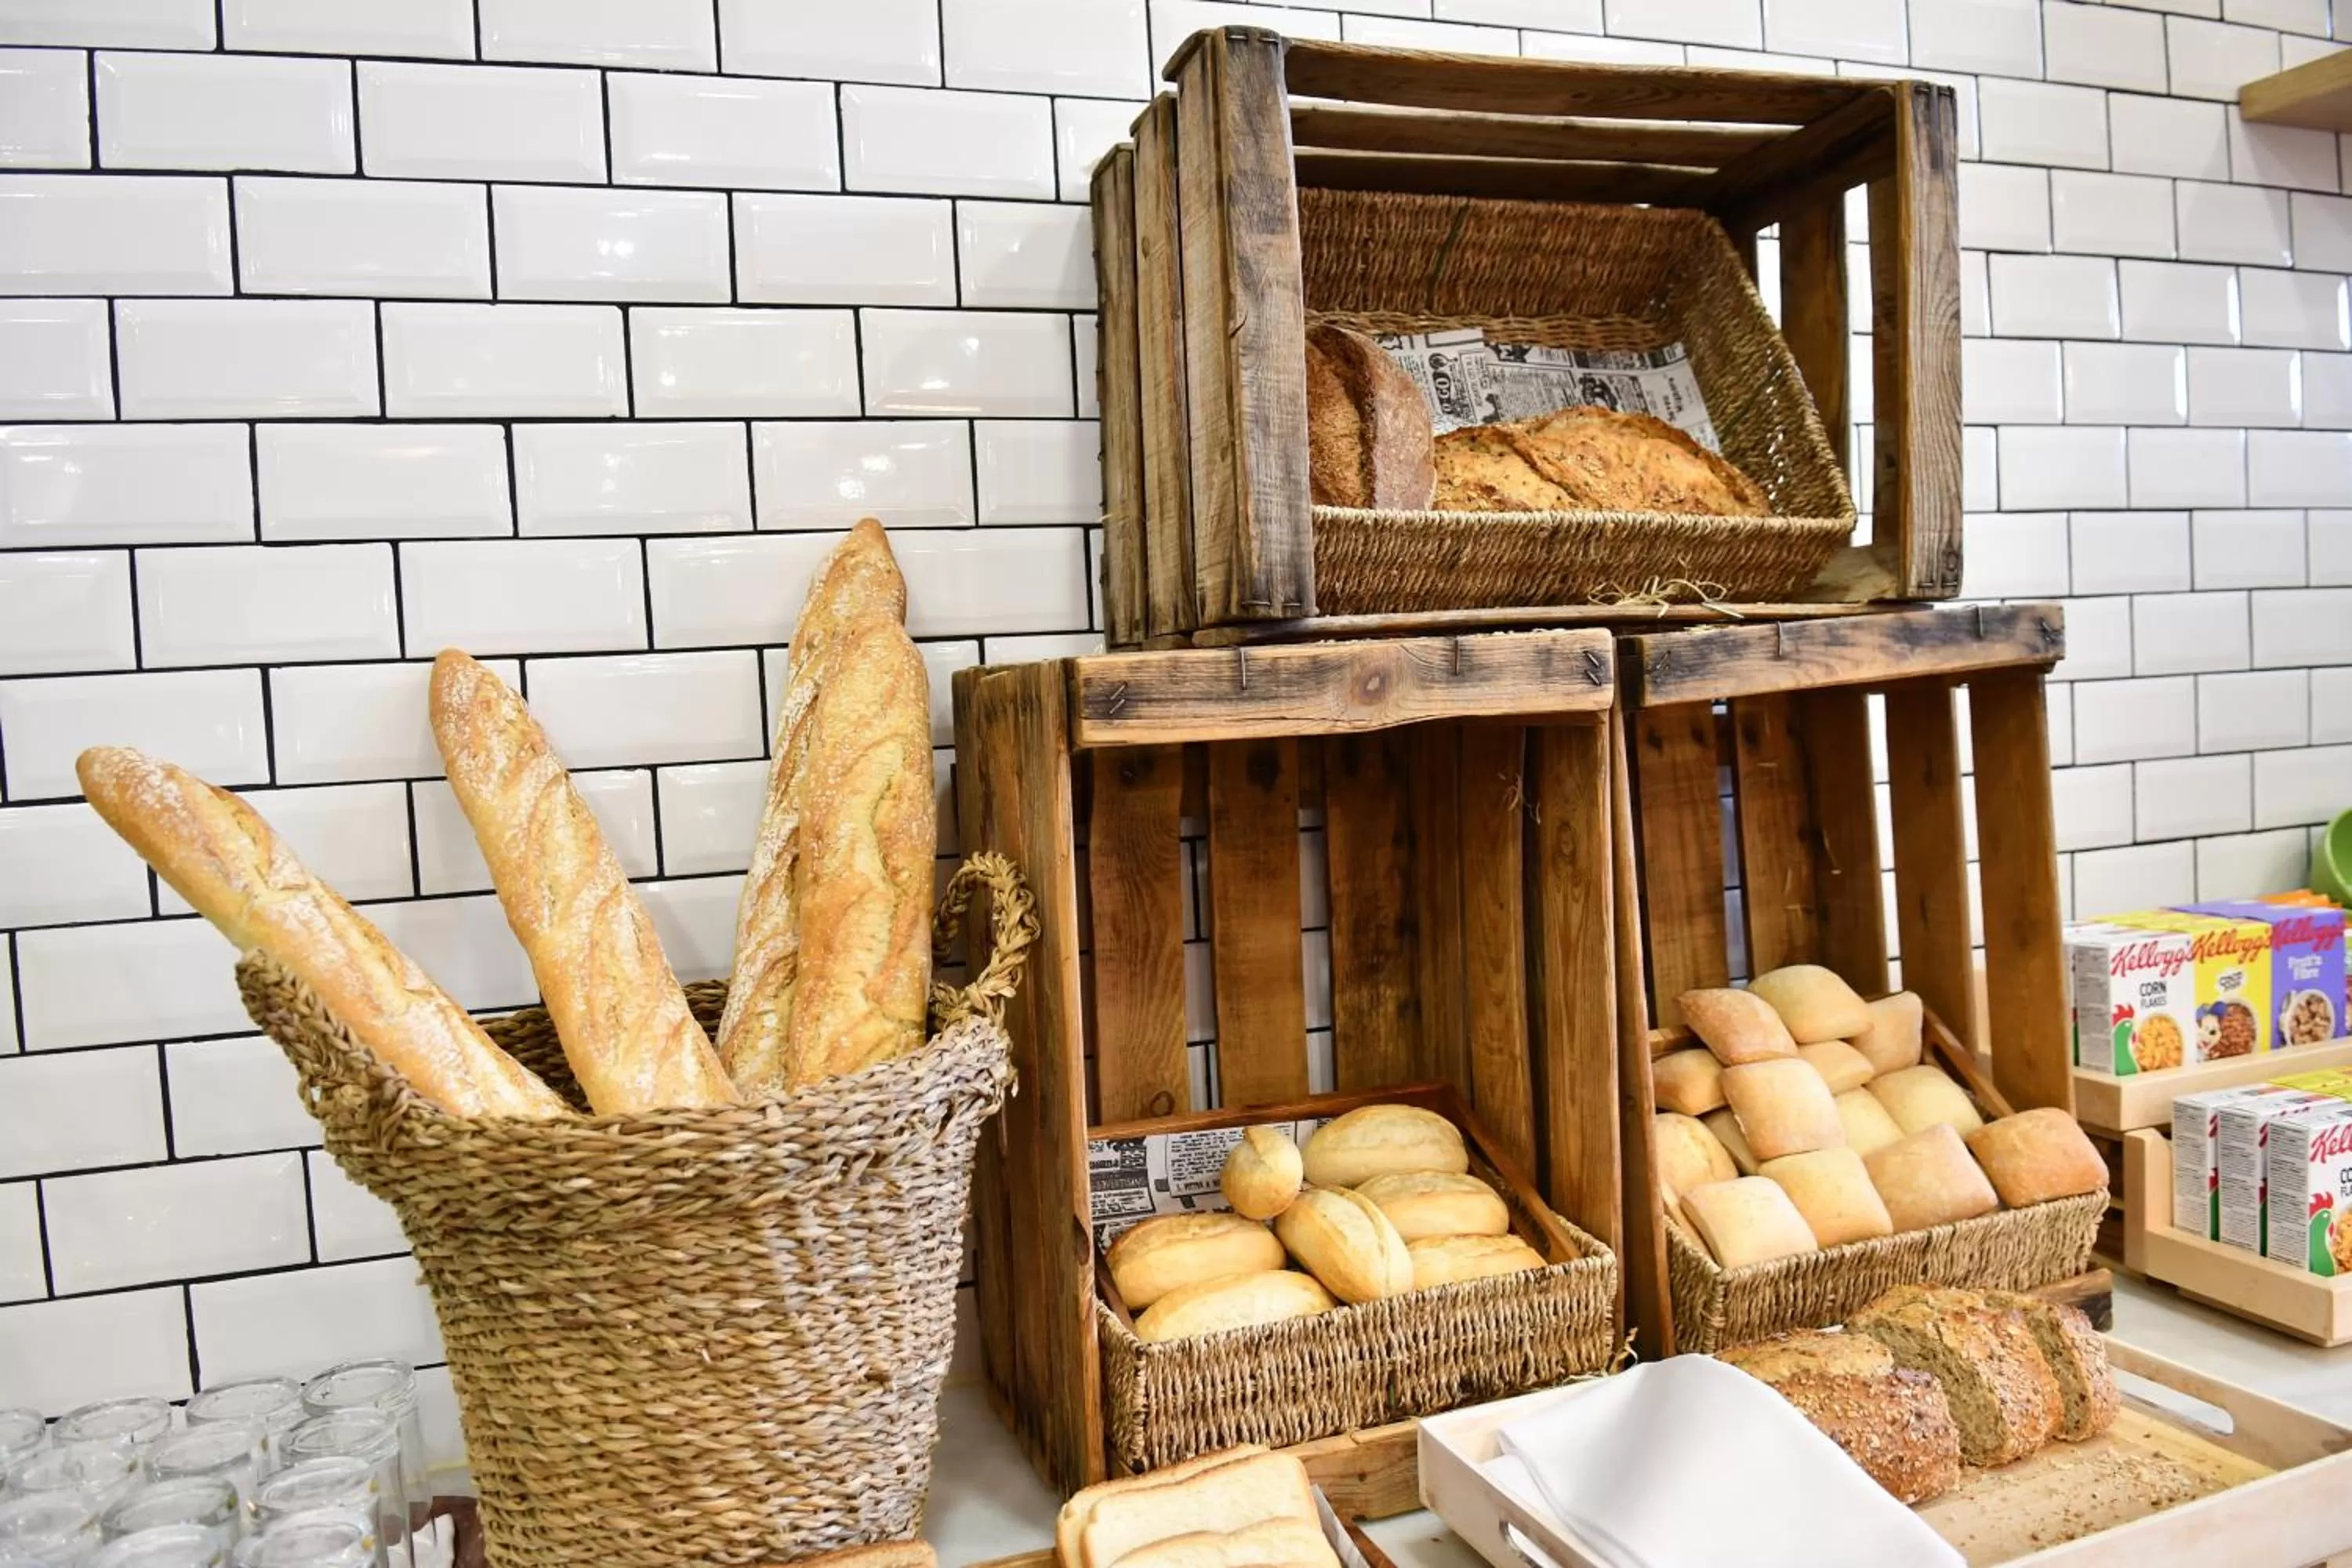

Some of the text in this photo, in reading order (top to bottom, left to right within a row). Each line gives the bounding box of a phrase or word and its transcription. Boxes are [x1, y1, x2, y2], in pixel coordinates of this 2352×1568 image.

[2111, 940, 2195, 977] Kellogg's
[2193, 927, 2271, 964] Kellogg's
[2139, 981, 2167, 996] CORN
